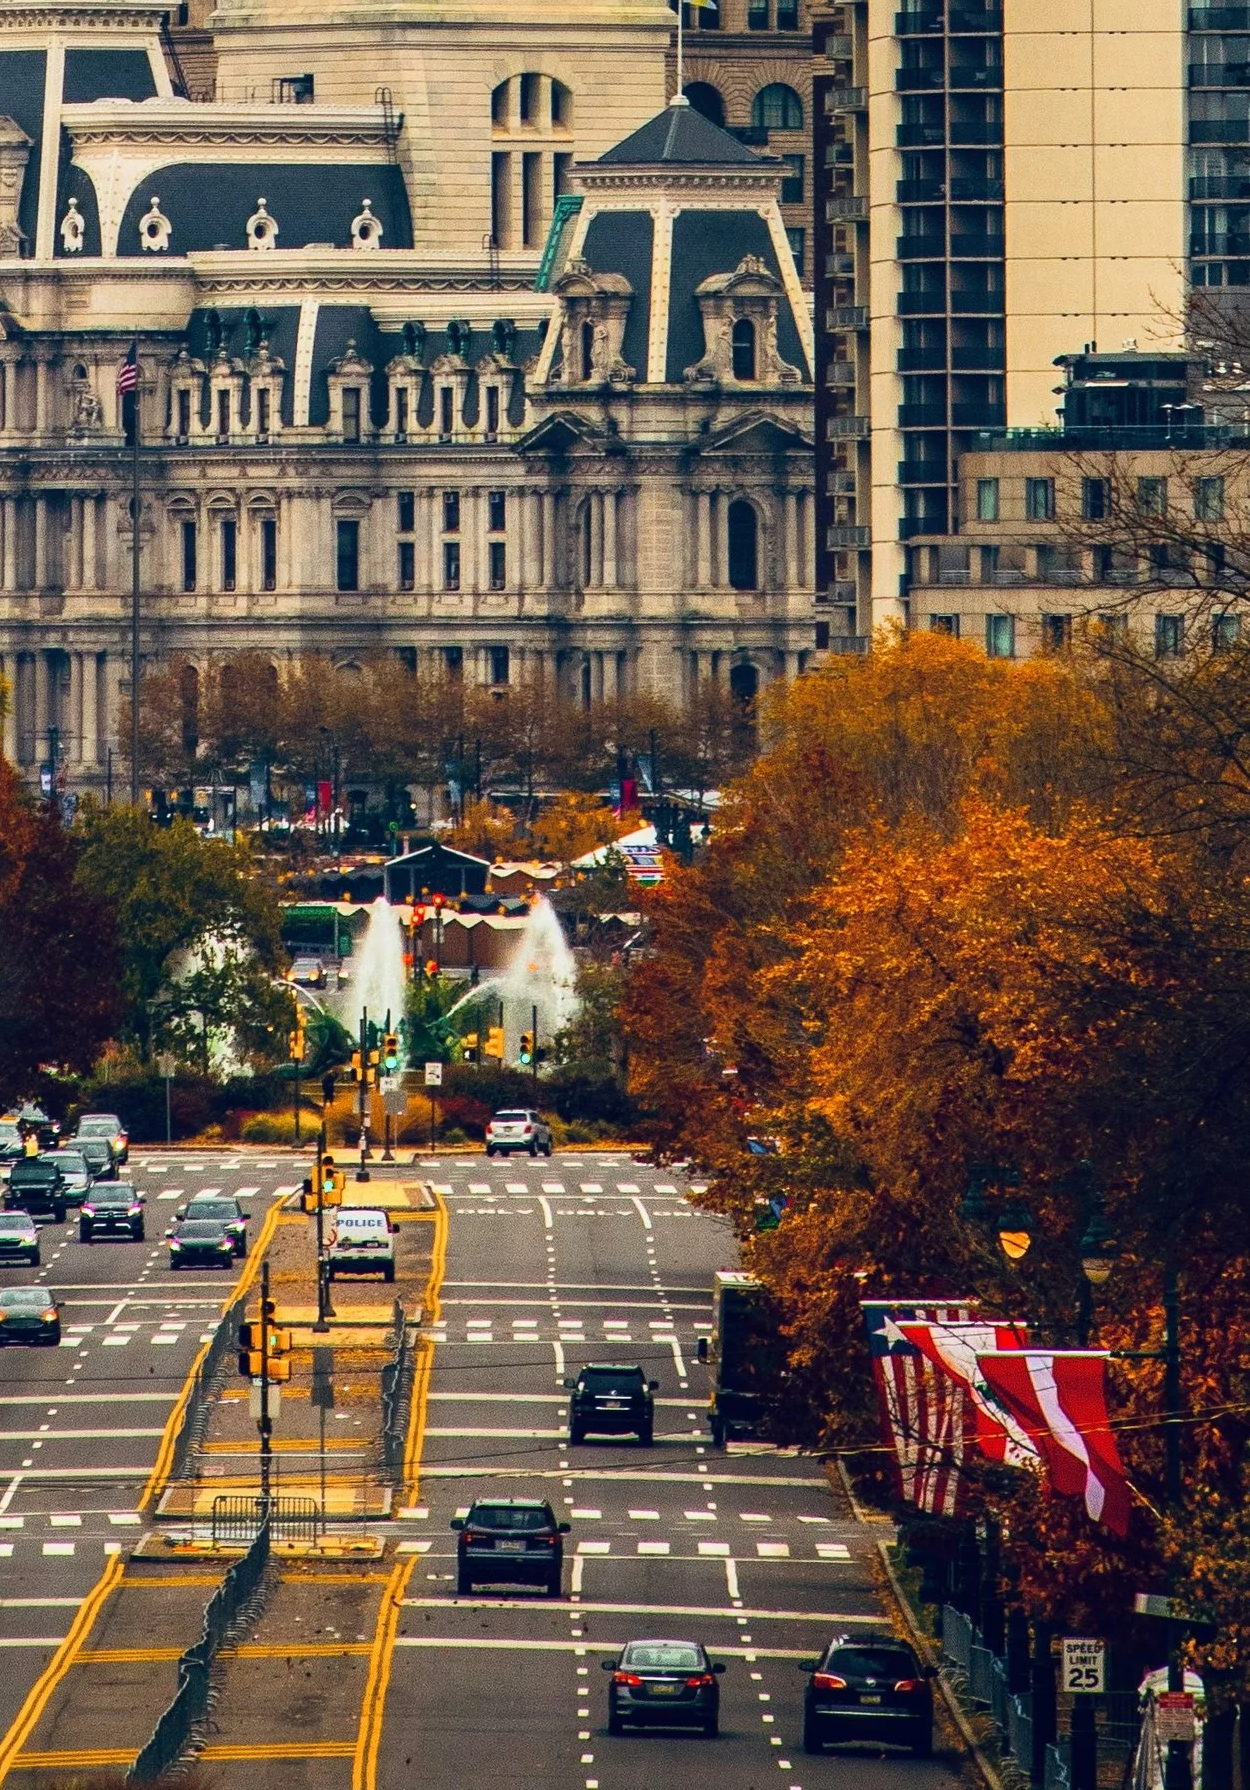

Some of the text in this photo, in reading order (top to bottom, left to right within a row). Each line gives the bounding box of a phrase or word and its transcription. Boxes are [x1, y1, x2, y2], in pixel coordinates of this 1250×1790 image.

[336, 1219, 384, 1227] POLICE
[1066, 1644, 1102, 1653] SPEED
[1069, 1656, 1097, 1665] LIMIT
[1069, 1668, 1099, 1688] 25
